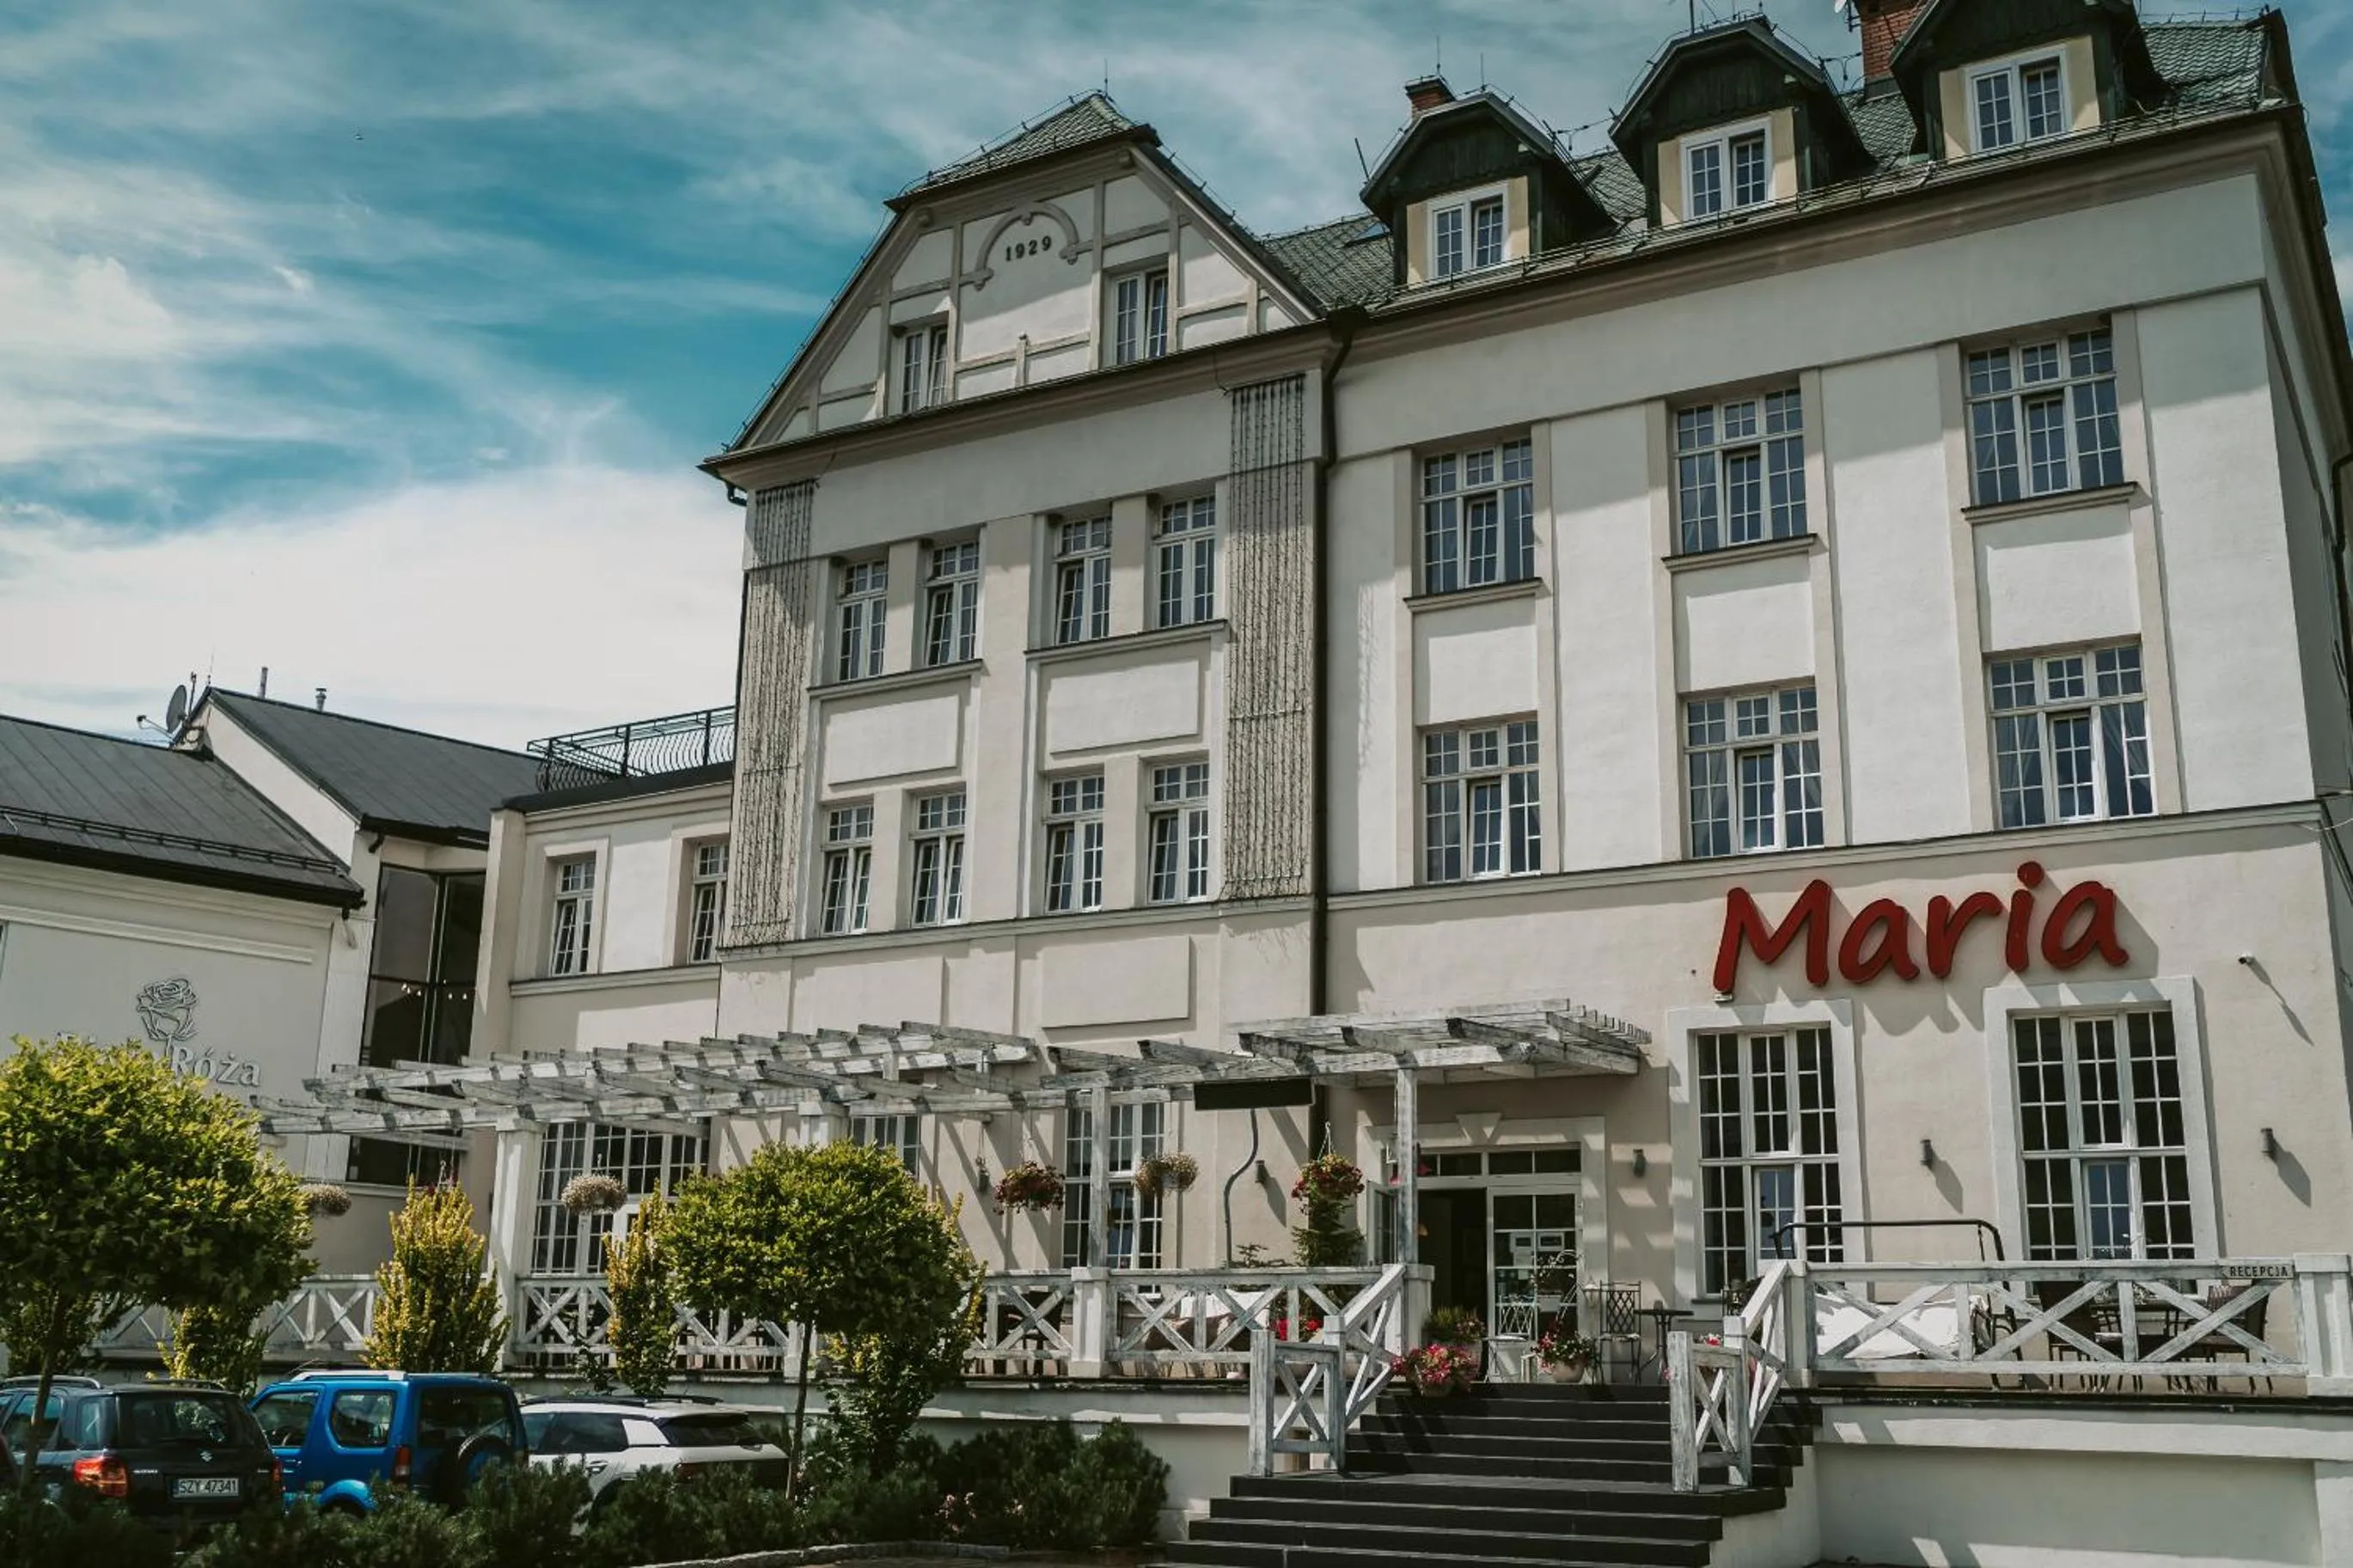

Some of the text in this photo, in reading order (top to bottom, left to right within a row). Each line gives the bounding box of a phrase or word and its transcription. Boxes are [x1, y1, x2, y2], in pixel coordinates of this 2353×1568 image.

[1005, 235, 1052, 262] 1929
[1713, 861, 2130, 994] Maria
[171, 1046, 260, 1087] Róża
[2229, 1266, 2289, 1277] RECEPCJA
[180, 1480, 236, 1493] SZY 47341
